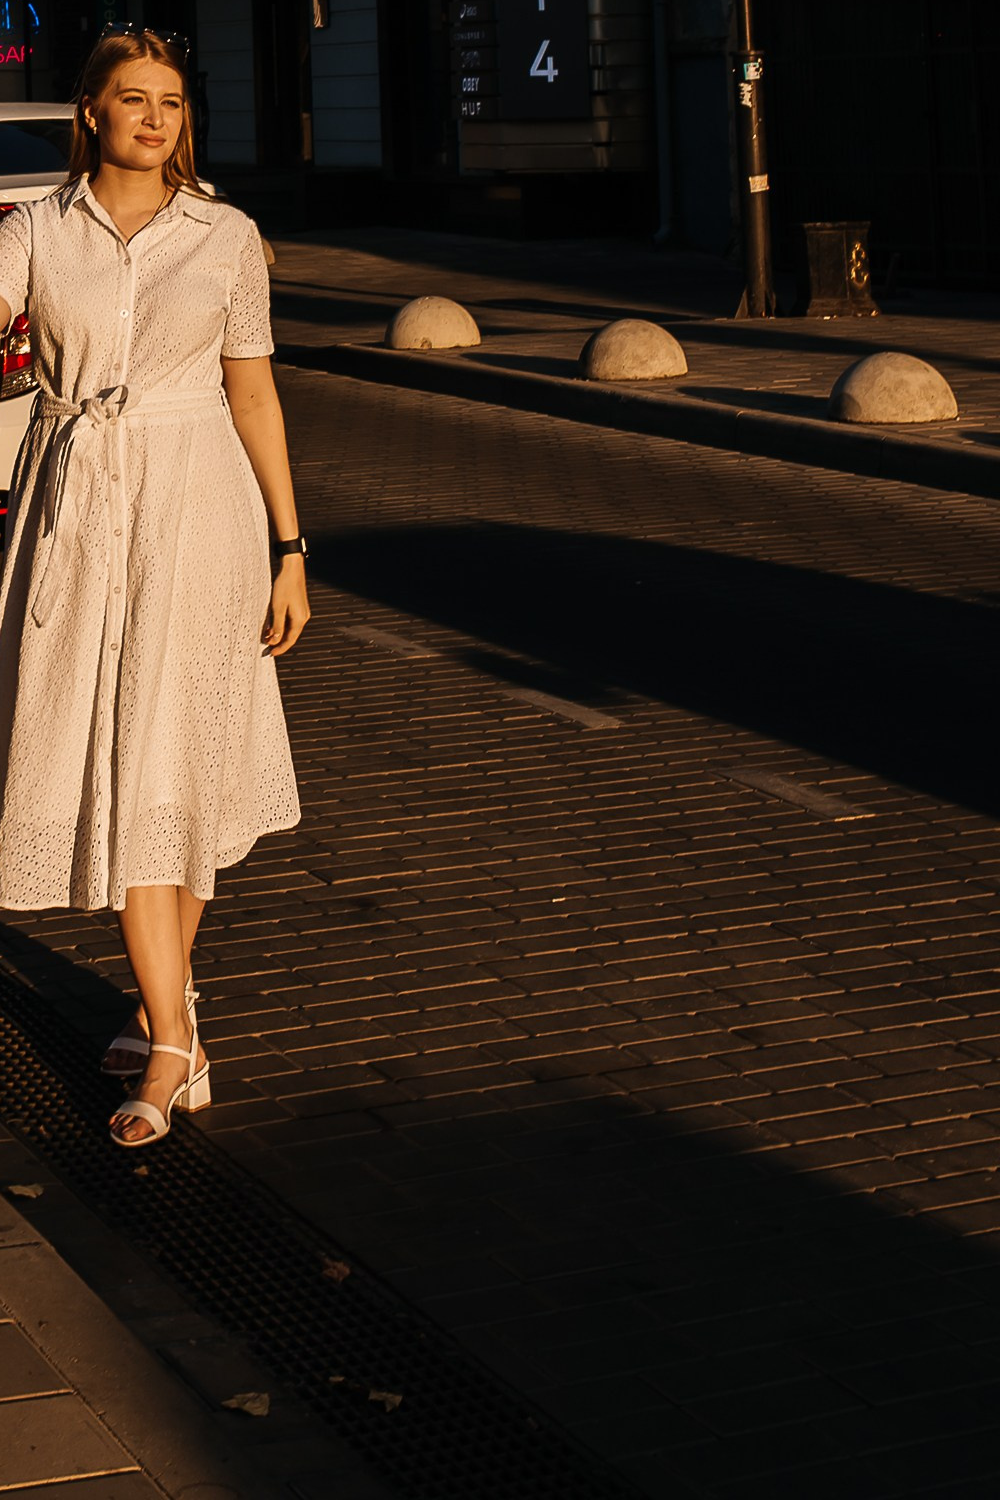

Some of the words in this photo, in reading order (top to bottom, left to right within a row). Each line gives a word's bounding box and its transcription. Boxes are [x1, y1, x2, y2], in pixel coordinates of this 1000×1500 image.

[529, 39, 559, 83] 4
[461, 77, 479, 92] OBEY
[460, 101, 481, 116] HUF
